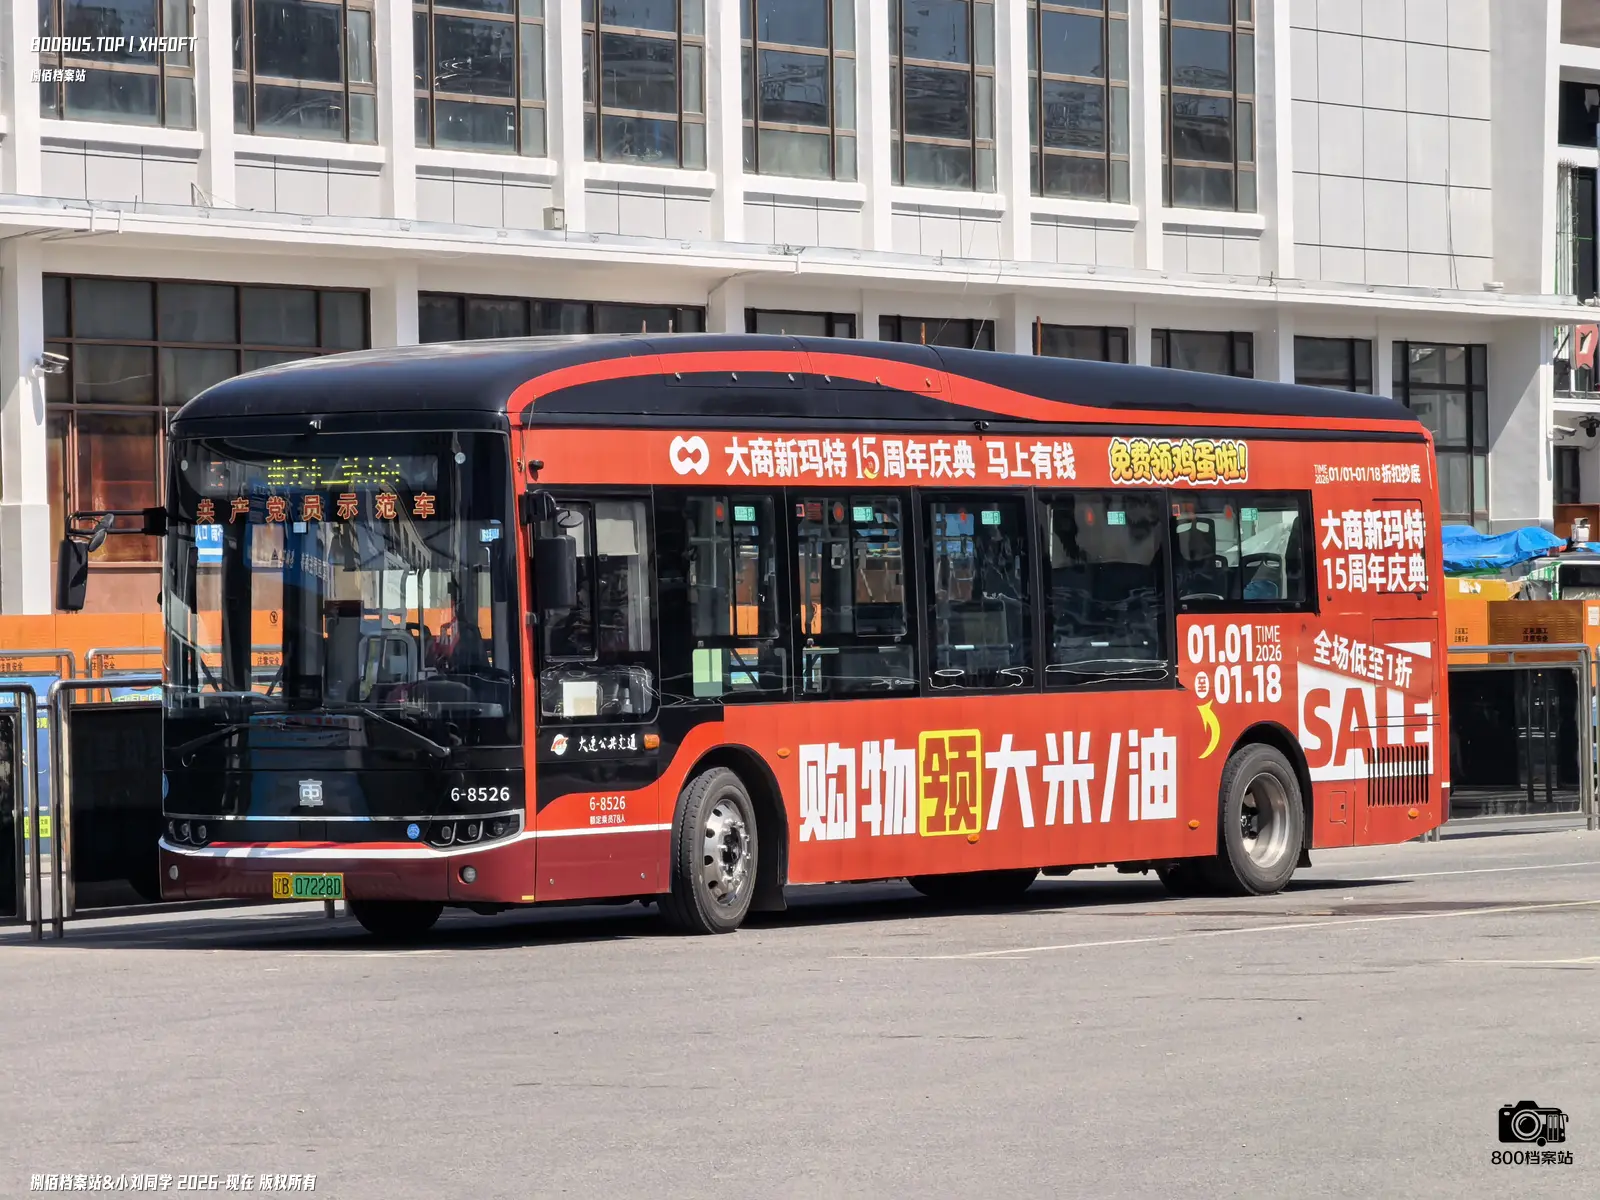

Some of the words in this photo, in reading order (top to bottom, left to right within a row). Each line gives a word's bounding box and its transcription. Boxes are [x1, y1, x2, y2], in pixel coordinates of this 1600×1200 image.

[986, 440, 1077, 480] 马上有钱
[1328, 466, 1381, 482] 01/01-01/18
[1315, 475, 1329, 484] 2026
[196, 492, 436, 524] 共产党员示范车
[1321, 509, 1426, 551] 大商新玛特
[1323, 553, 1428, 593] 15周年庆典
[1187, 624, 1253, 664] 01.01
[1256, 625, 1281, 643] TIME
[1255, 644, 1282, 662] 2026
[1313, 629, 1413, 689] 全场低至1折
[1214, 664, 1282, 704] 01.18
[1303, 686, 1430, 770] SALE
[450, 786, 511, 802] 6-8526
[589, 796, 626, 811] 6-8526
